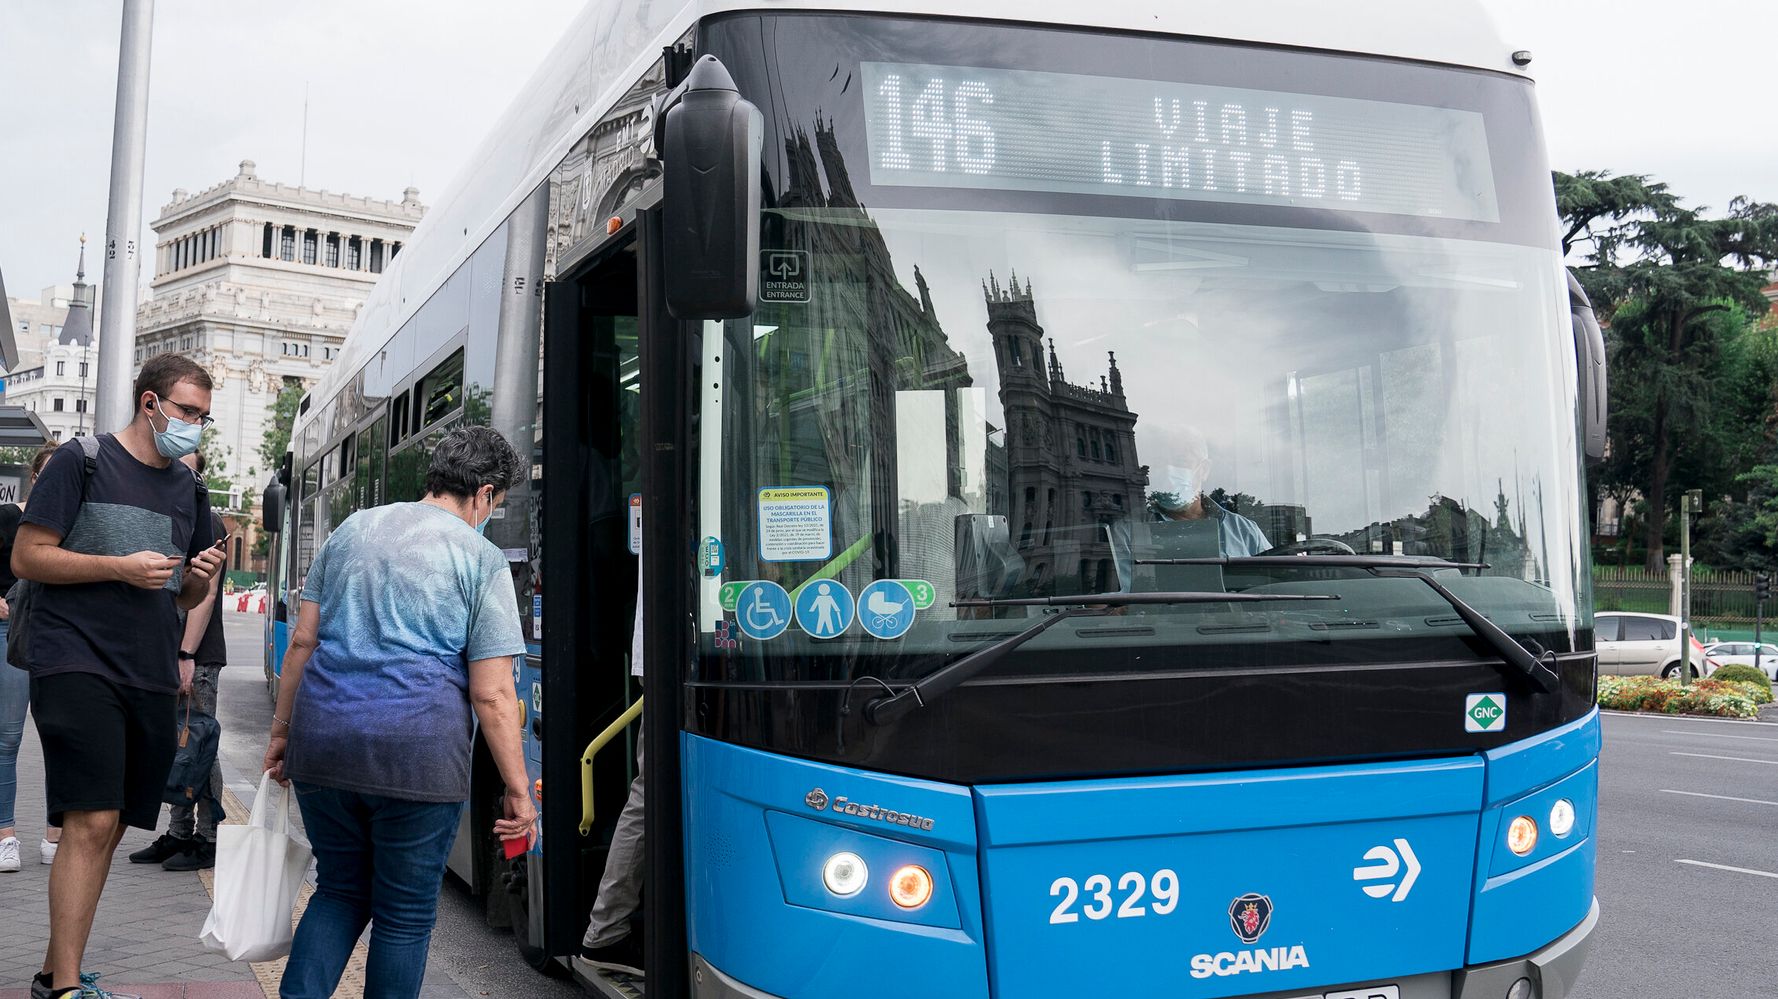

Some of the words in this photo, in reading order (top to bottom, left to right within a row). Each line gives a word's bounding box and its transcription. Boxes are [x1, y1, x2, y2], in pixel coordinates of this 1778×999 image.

[616, 116, 635, 152] EMT
[879, 75, 996, 174] 146
[1154, 97, 1316, 152] VIAJE
[1101, 141, 1362, 201] LIMITADO
[766, 281, 805, 290] ENTRADA
[766, 291, 805, 299] ENTRANCE
[724, 586, 734, 602] 2
[916, 584, 928, 601] 3
[1474, 706, 1498, 719] GNC
[832, 795, 935, 831] Castrosua
[1049, 868, 1181, 924] 2329
[1189, 945, 1310, 979] SCANIA
